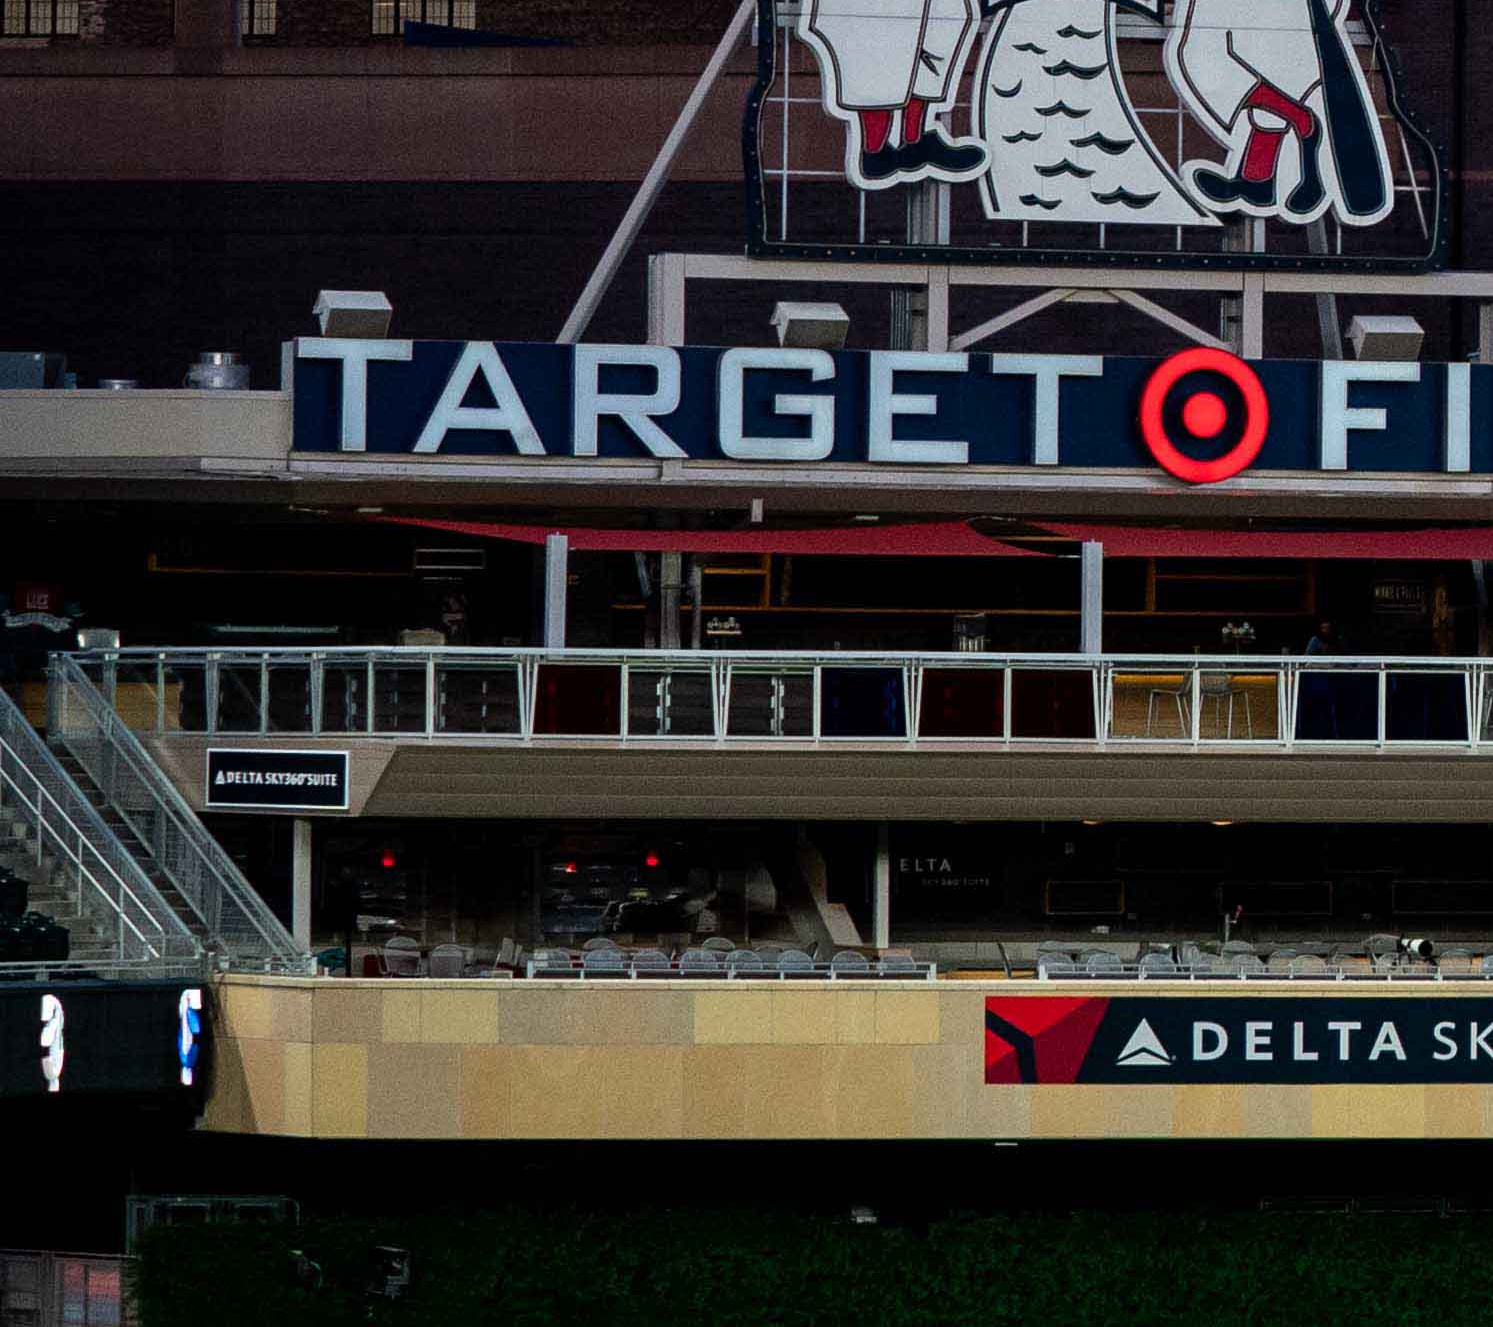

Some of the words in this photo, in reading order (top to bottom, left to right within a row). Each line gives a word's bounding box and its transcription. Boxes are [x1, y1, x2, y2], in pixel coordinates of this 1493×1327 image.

[297, 336, 1104, 467] TARGET
[226, 770, 263, 784] DELTA
[899, 857, 953, 873] ELTA
[1192, 1021, 1408, 1061] DELTA
